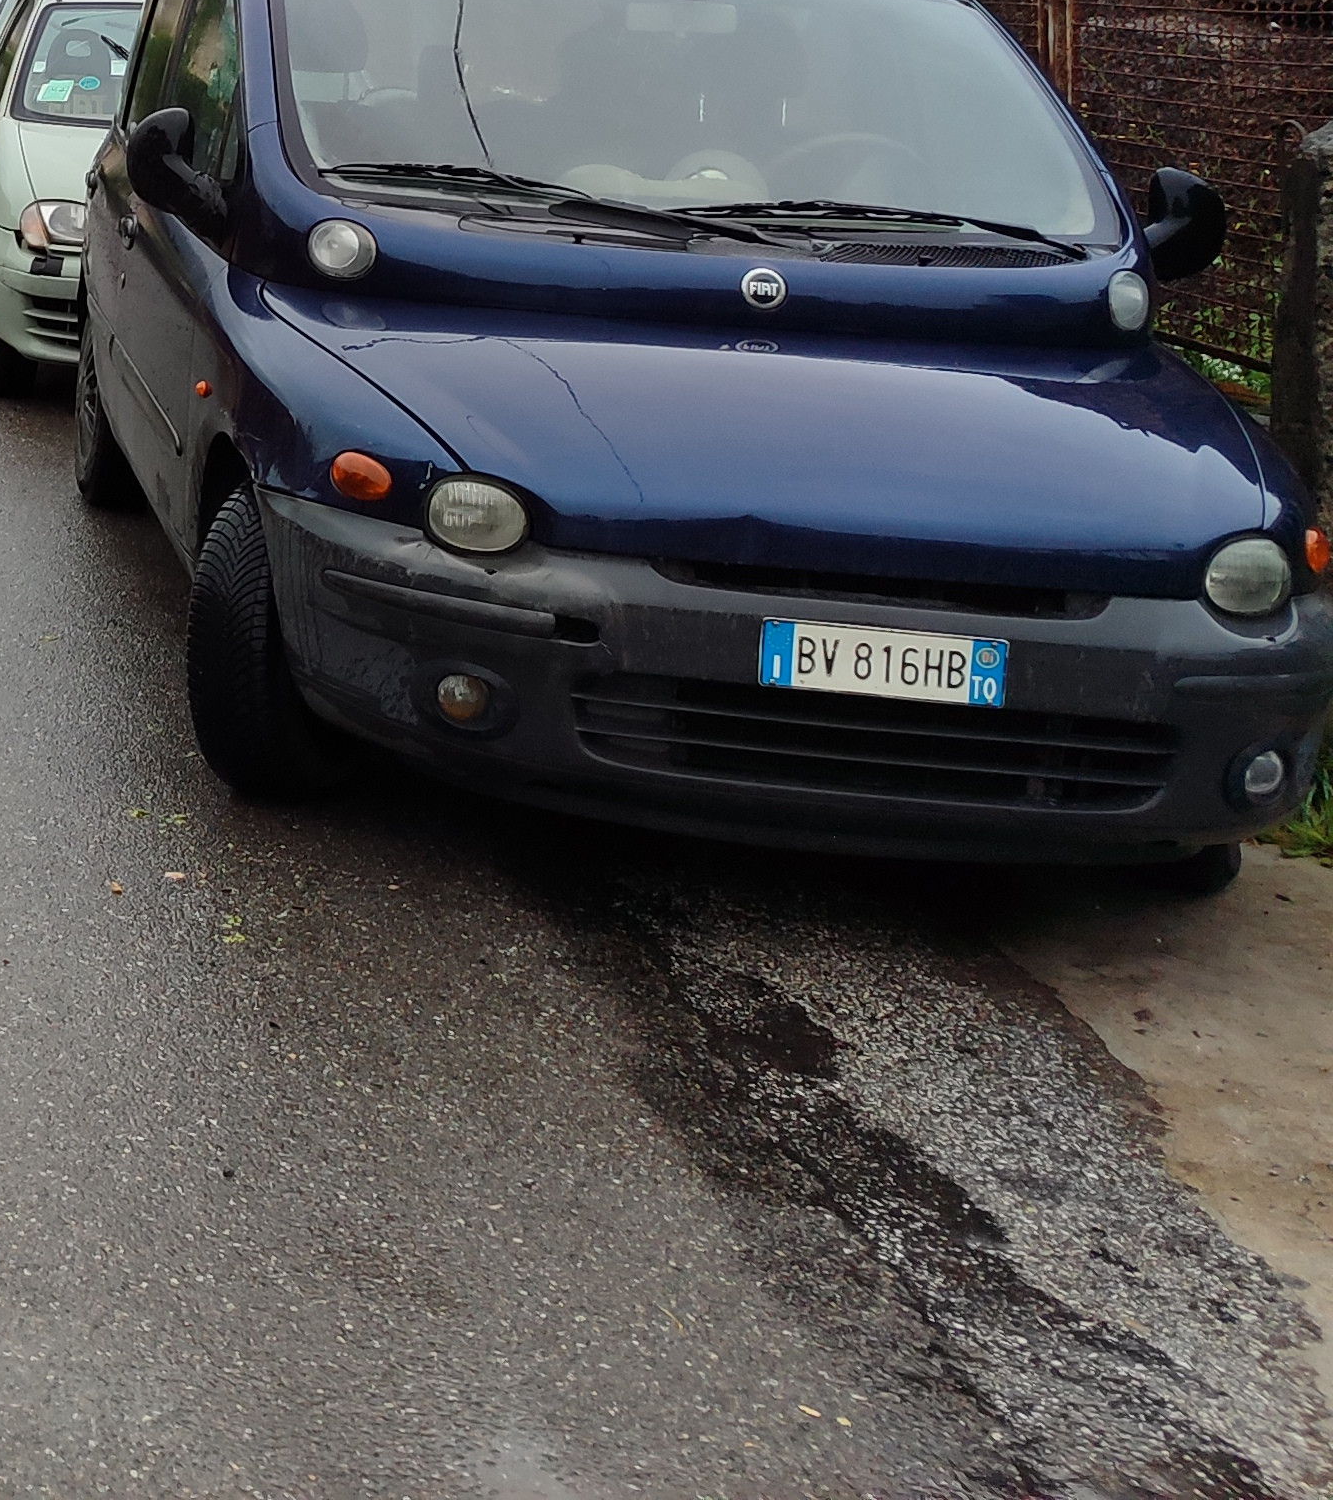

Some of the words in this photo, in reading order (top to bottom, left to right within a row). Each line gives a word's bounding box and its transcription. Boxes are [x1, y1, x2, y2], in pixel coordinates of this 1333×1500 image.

[749, 281, 779, 297] FIAT
[797, 636, 840, 677] BV
[854, 642, 967, 689] 816HB
[971, 675, 997, 700] TO
